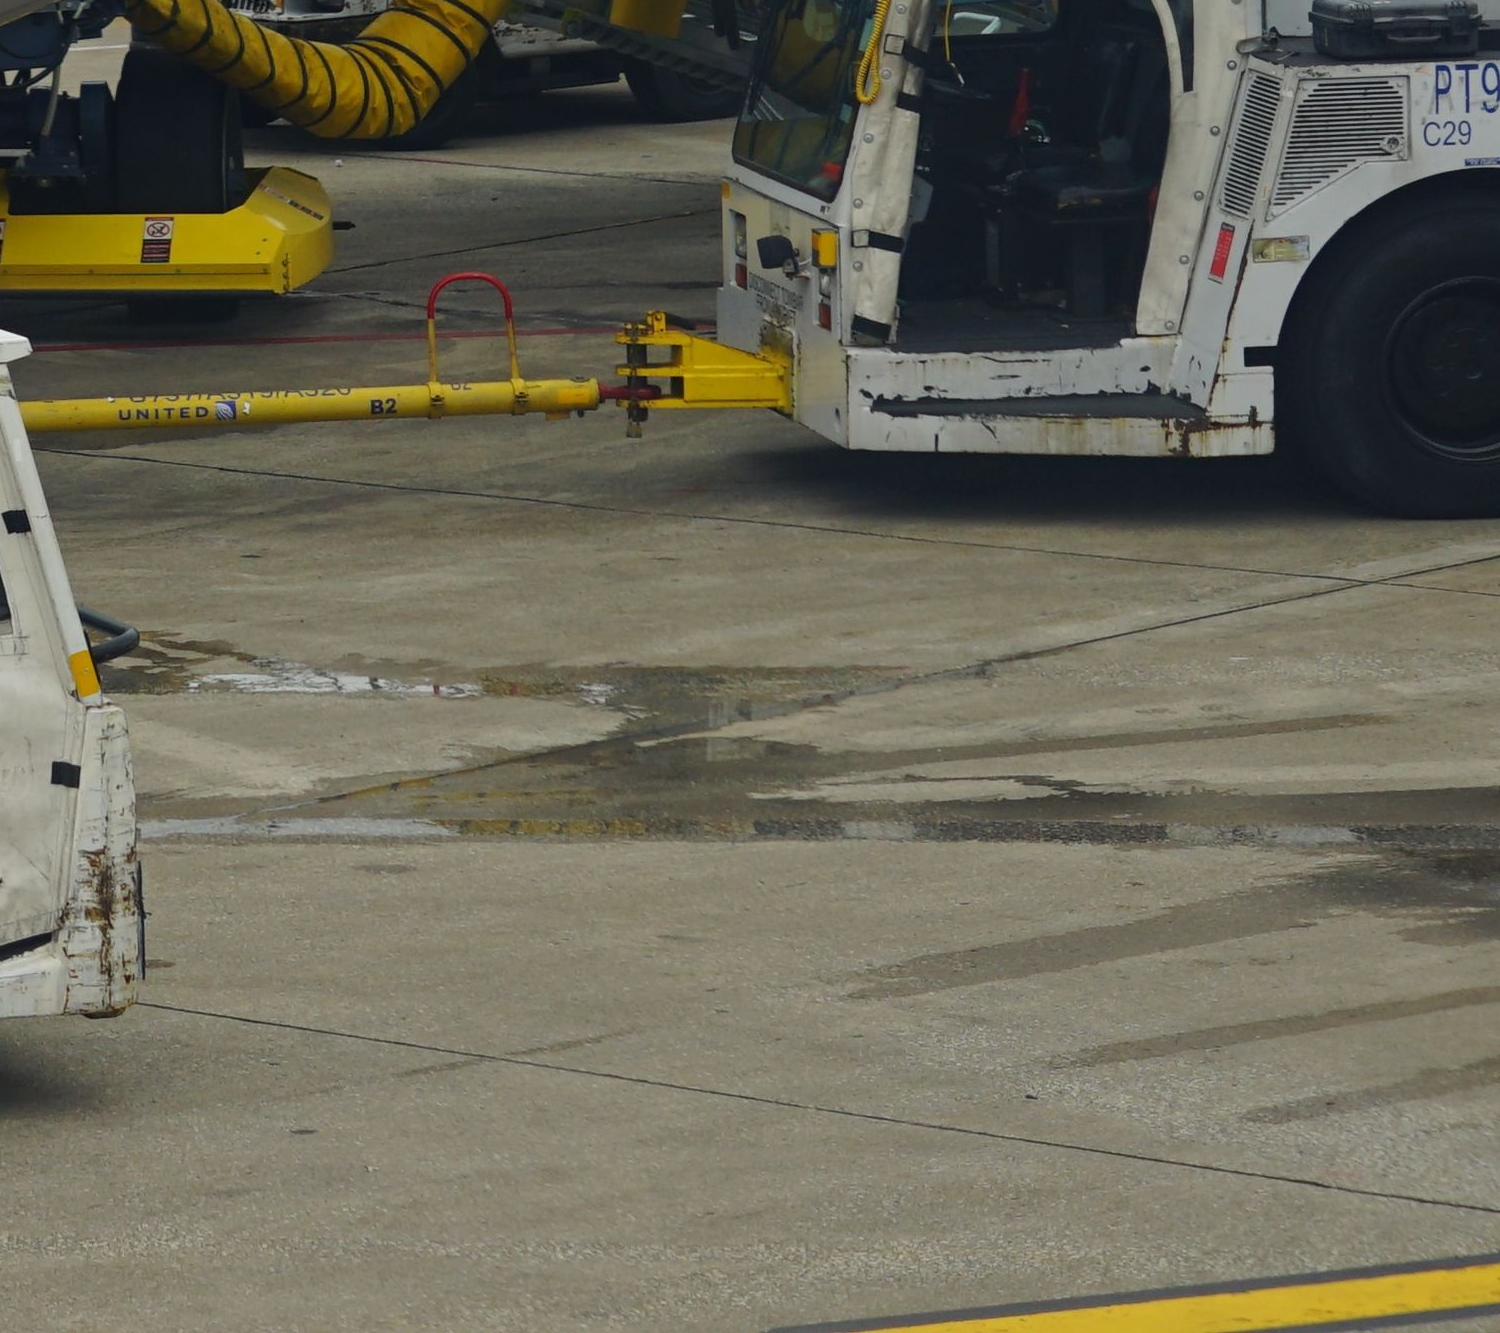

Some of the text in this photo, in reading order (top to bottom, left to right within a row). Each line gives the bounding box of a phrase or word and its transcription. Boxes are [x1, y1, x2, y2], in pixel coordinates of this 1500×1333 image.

[1423, 120, 1472, 147] C29
[119, 406, 209, 421] UNITED
[370, 398, 397, 415] B2
